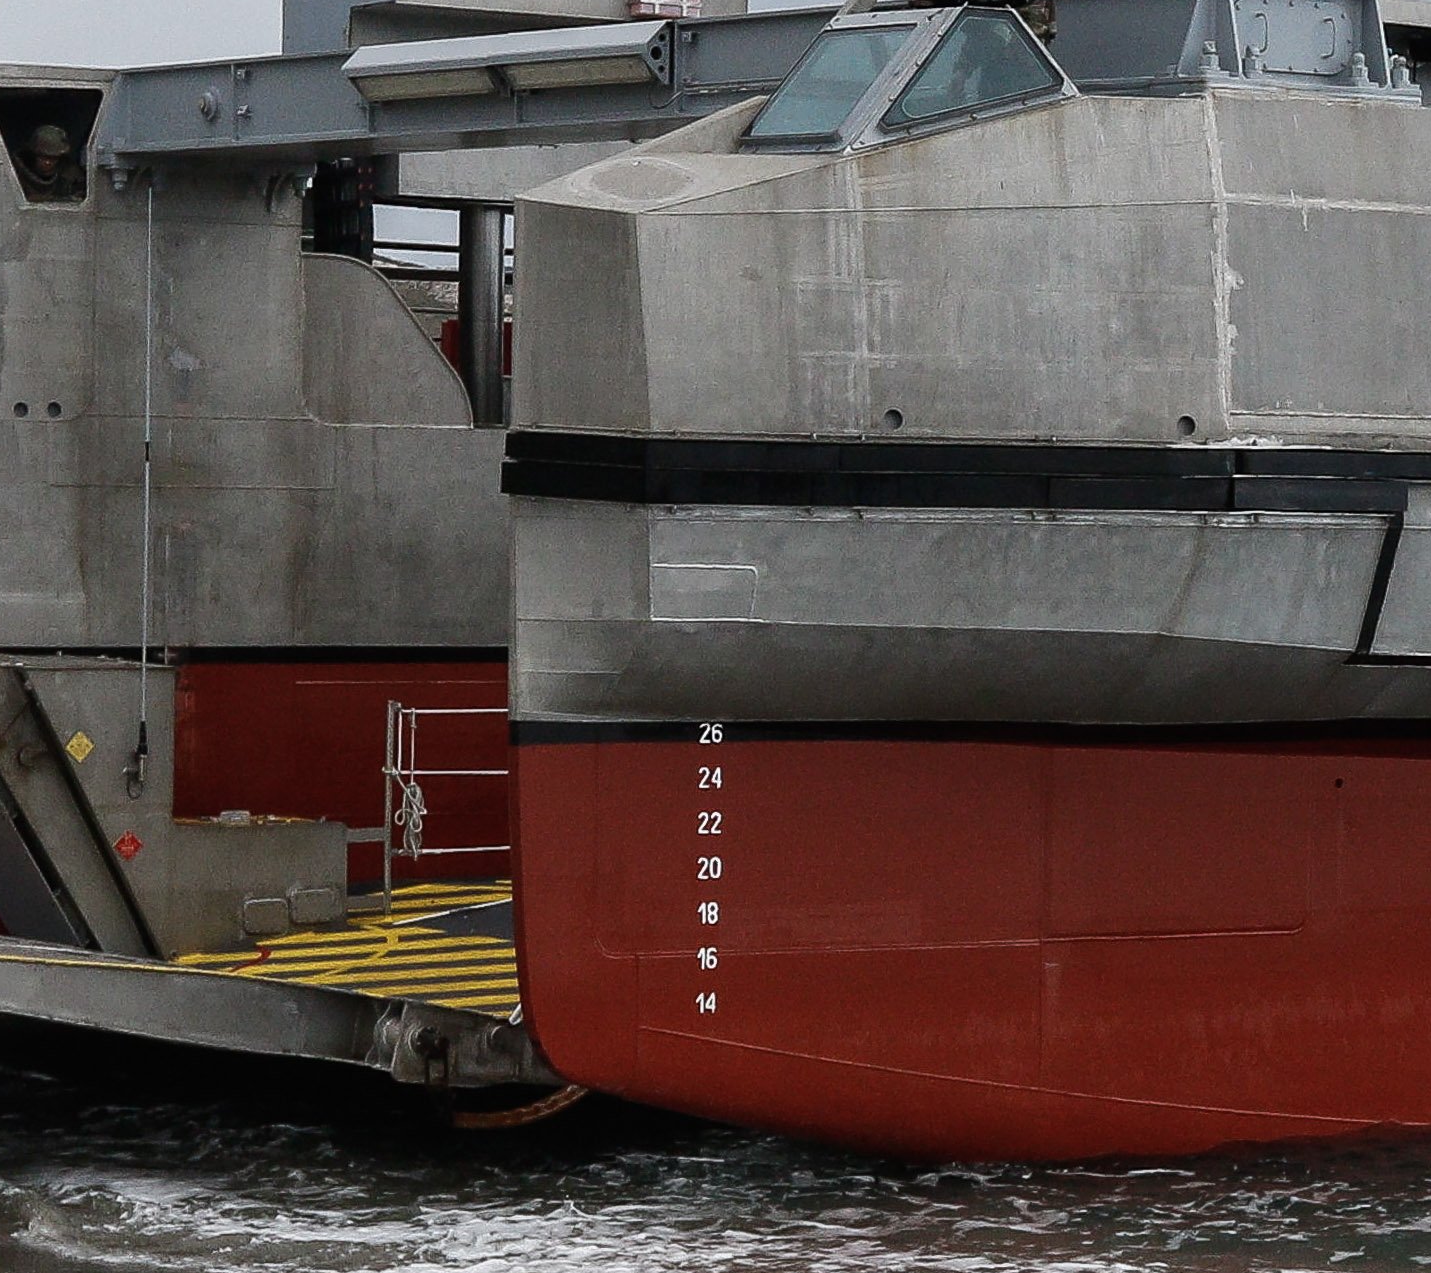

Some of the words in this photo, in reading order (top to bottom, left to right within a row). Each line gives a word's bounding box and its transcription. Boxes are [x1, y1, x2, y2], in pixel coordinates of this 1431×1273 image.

[699, 722, 723, 743] 26
[698, 766, 722, 788] 24
[697, 811, 722, 834] 22
[697, 856, 722, 879] 20
[697, 901, 719, 924] 18
[697, 947, 718, 969] 16
[695, 992, 717, 1014] 14
